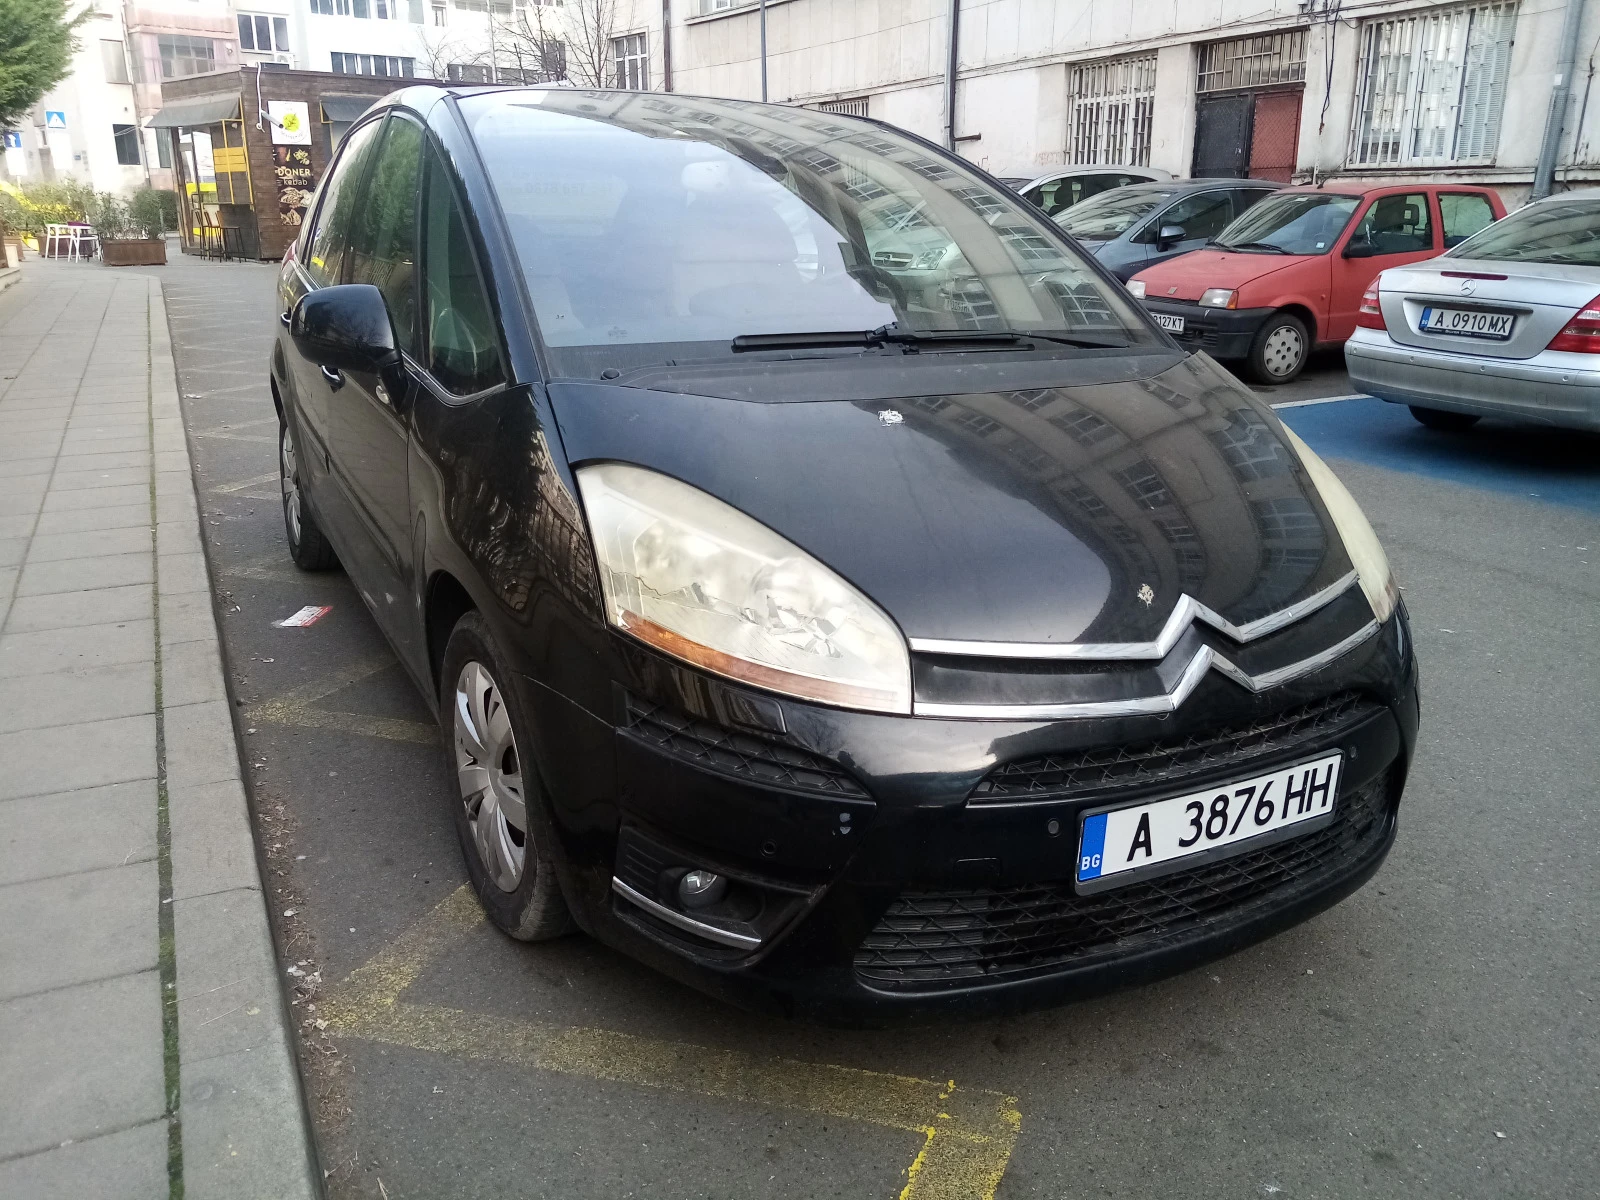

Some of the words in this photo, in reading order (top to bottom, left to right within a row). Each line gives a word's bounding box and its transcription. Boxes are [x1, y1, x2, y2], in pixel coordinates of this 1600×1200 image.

[283, 178, 308, 186] kebab
[1127, 812, 1153, 862] A
[1081, 853, 1101, 870] BG
